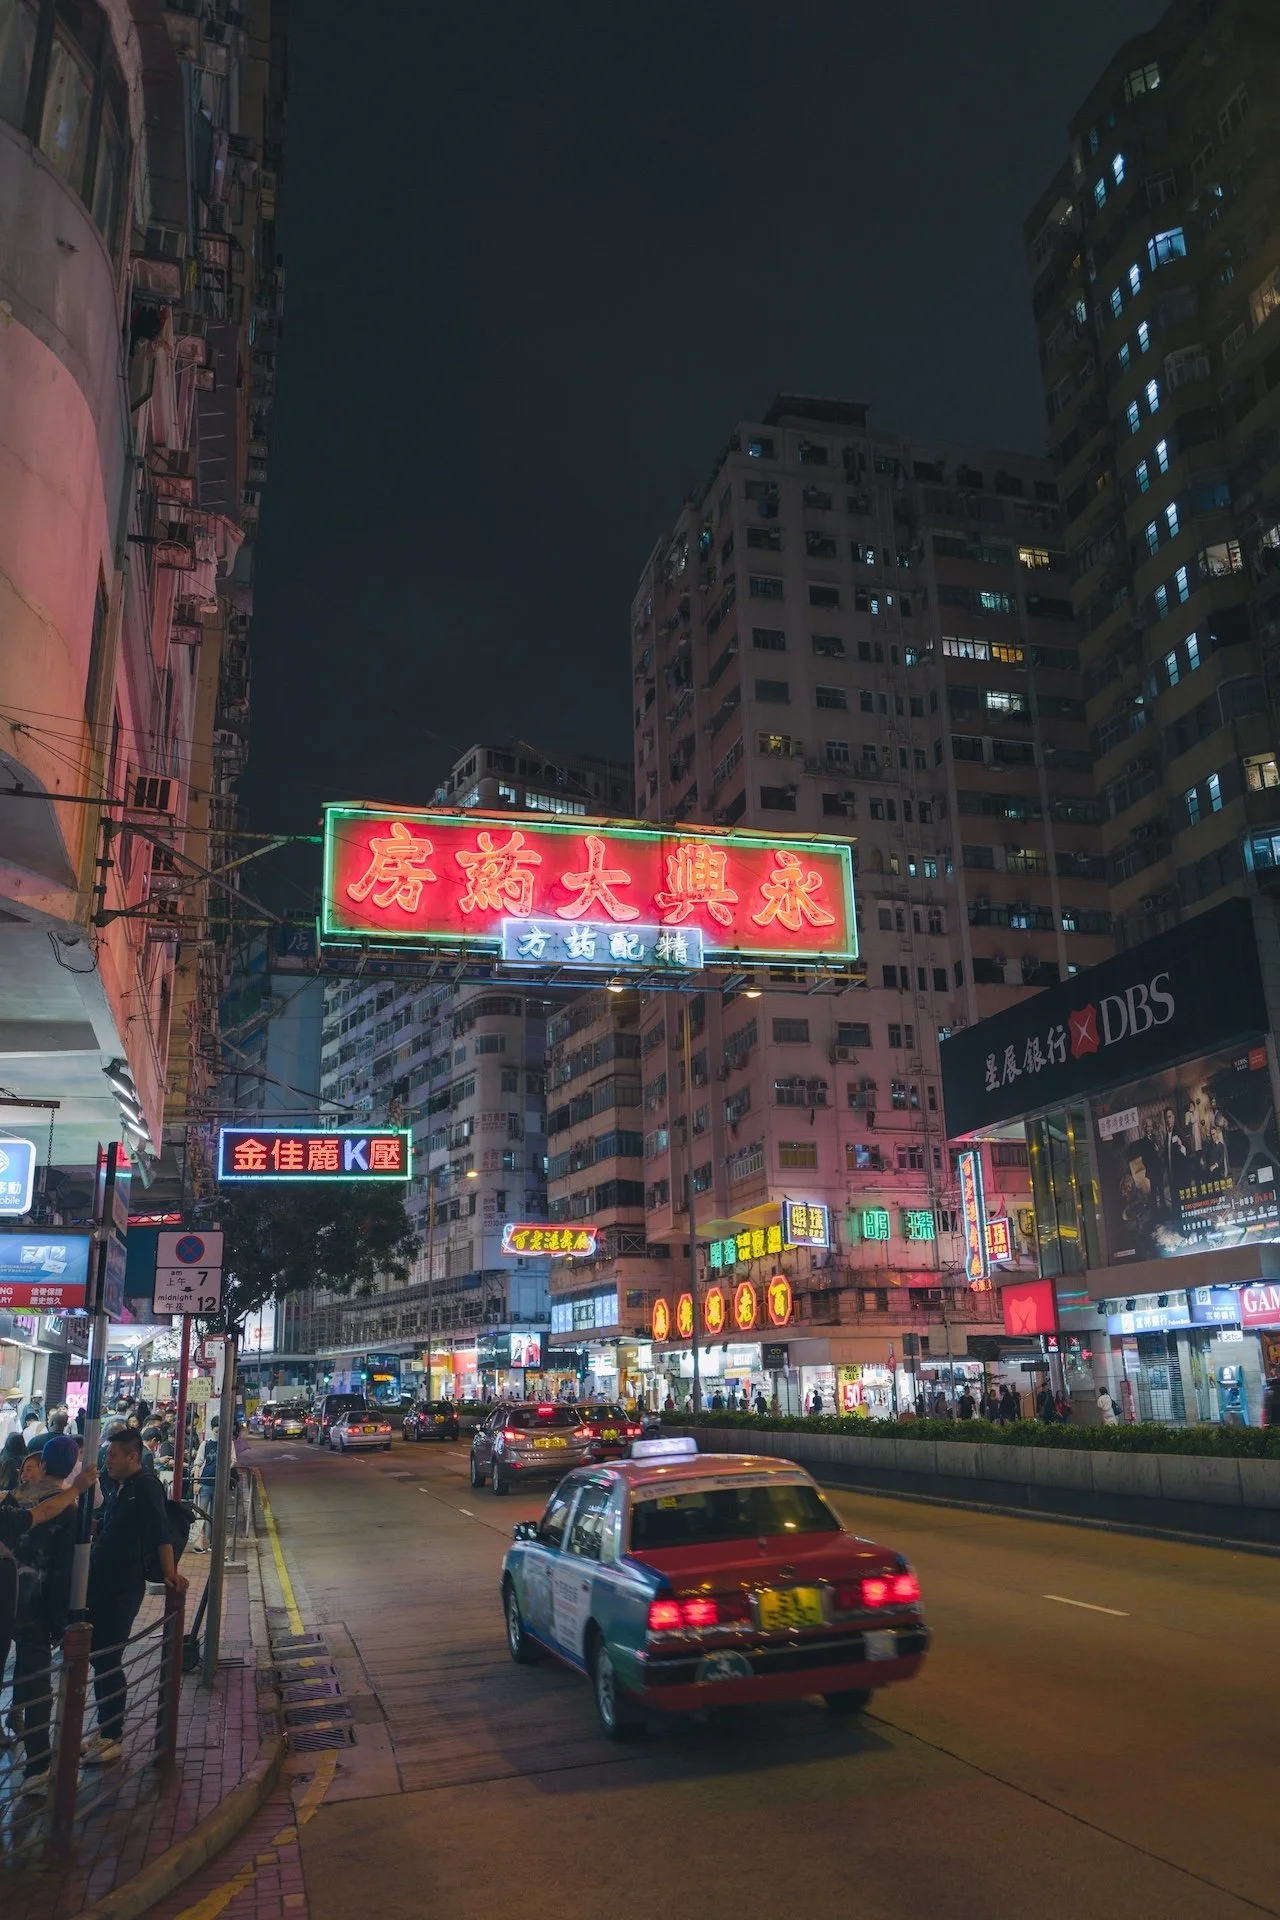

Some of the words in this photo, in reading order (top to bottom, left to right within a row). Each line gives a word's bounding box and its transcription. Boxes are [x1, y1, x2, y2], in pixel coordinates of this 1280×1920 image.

[985, 1025, 1067, 1091] 星展銀行
[1099, 972, 1175, 1046] DBS
[863, 1210, 935, 1241] 明珠
[166, 1277, 187, 1287] 上午
[198, 1271, 208, 1286] 7
[158, 1294, 193, 1302] midnight
[198, 1296, 217, 1312] 12
[165, 1302, 185, 1312] 午夜
